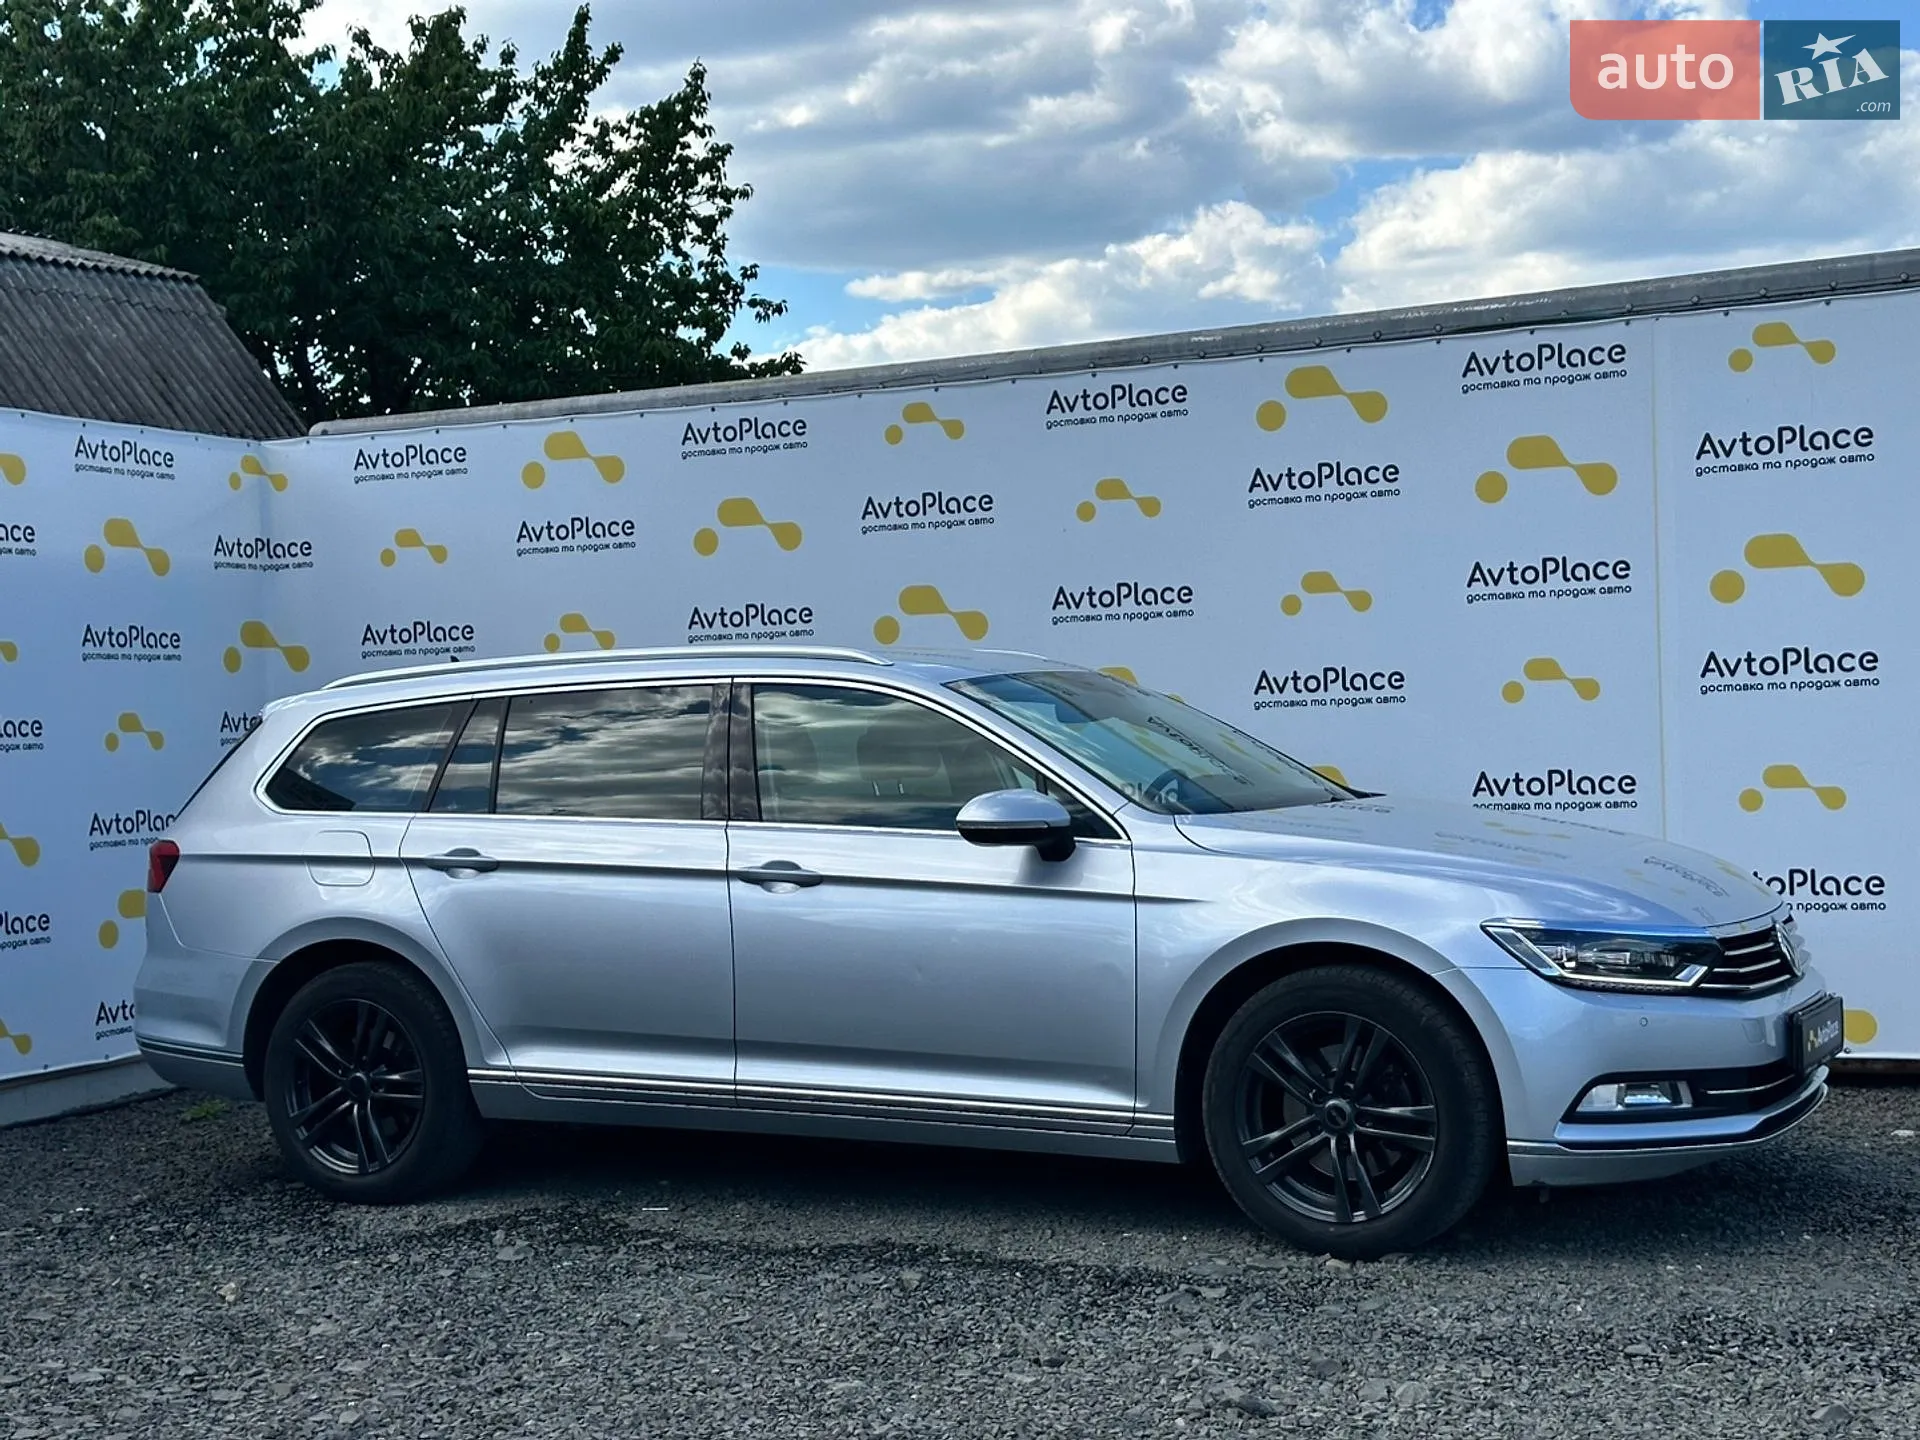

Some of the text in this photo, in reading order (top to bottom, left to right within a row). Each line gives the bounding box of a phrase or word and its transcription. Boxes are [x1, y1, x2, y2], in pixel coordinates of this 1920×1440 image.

[1462, 342, 1626, 378] AvtoPlace
[1046, 383, 1187, 415] AvtoPlace
[681, 417, 807, 446] AvtoPlace
[1696, 424, 1873, 460] AvtoPlace
[75, 435, 174, 468] AvtoPlace
[354, 444, 466, 471] AvtoPlace
[1248, 461, 1399, 493] AvtoPlace
[861, 491, 993, 520] AvtoPlace
[517, 516, 635, 543] AvtoPlace
[214, 535, 312, 559] AvtoPlace
[1467, 556, 1631, 588] AvtoPlace
[1052, 582, 1193, 611] AvtoPlace
[688, 603, 813, 630] AvtoPlace
[82, 624, 180, 649] AvtoPlace
[362, 621, 474, 645] AvtoPlace
[1700, 647, 1878, 678] AvtoPlace
[1254, 666, 1405, 695] AvtoPlace
[0, 719, 43, 738] ace
[1472, 769, 1636, 797] AvtoPlace
[0, 911, 50, 935] lace
